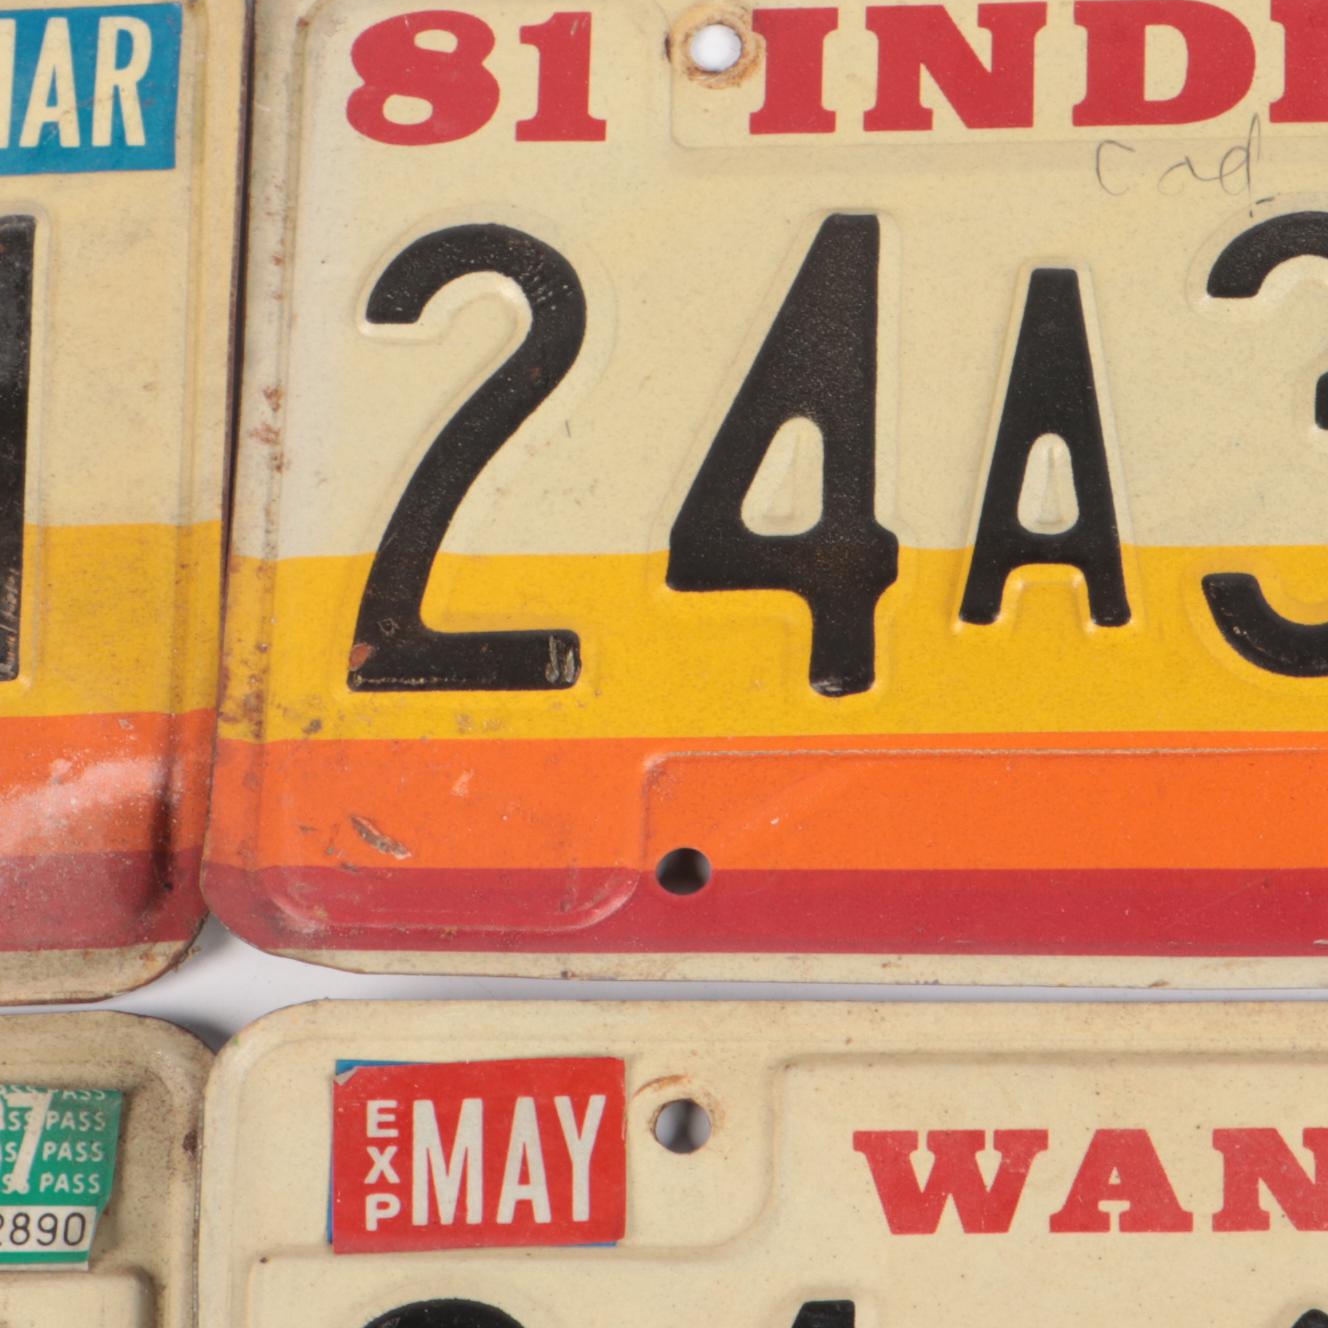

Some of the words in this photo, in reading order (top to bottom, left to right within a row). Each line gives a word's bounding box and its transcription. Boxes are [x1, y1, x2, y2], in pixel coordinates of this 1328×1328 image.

[347, 9, 606, 146] 81
[46, 1110, 106, 1132] PASS
[42, 1141, 104, 1162] PASS
[365, 1099, 401, 1231] EXP
[411, 1095, 606, 1226] MAY
[39, 1172, 100, 1194] PASS
[0, 1212, 86, 1246] 890
